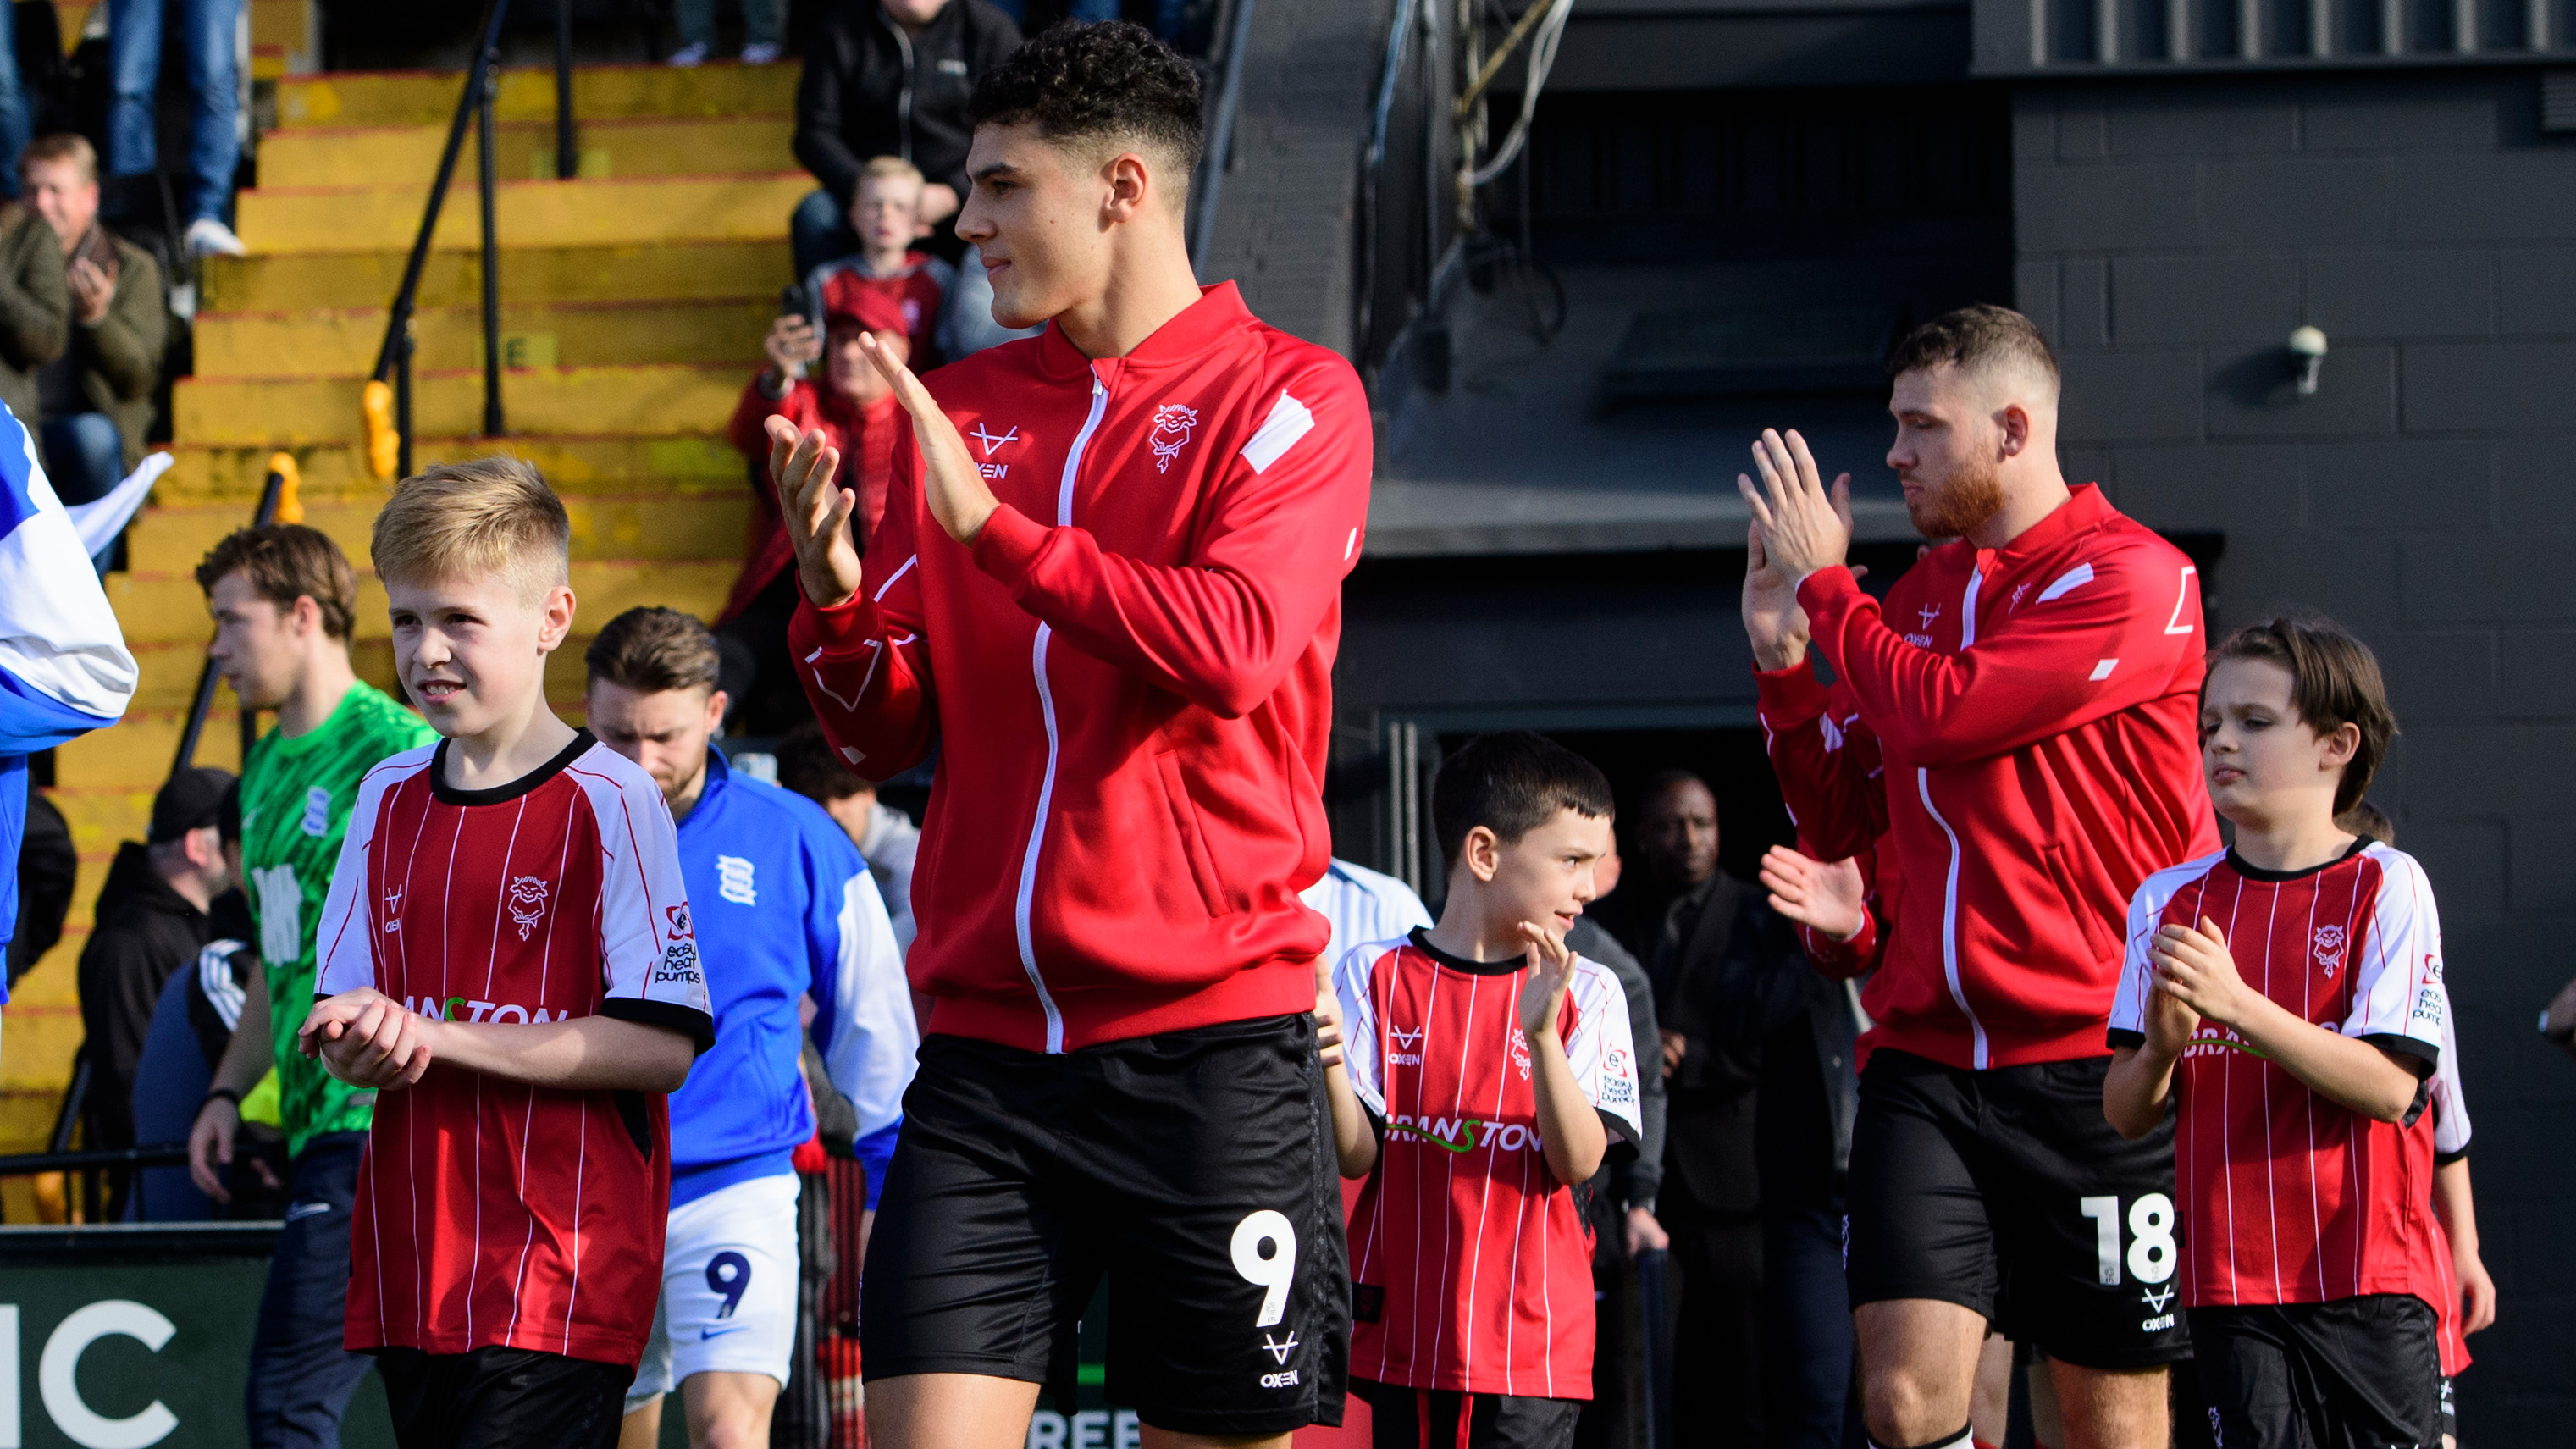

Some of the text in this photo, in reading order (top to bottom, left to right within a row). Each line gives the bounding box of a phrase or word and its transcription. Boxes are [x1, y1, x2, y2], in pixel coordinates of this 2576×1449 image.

[974, 462, 1009, 479] XEN
[667, 943, 696, 960] easy
[664, 956, 696, 971] heat
[655, 971, 701, 984] pumps
[2421, 989, 2441, 1003] eas
[2419, 998, 2441, 1014] hea
[1389, 1054, 1421, 1066] OXEN
[2081, 1193, 2177, 1286] 18
[1230, 1209, 1297, 1327] 9
[706, 1251, 751, 1319] 9
[2142, 1314, 2175, 1332] OXEN
[1260, 1369, 1299, 1388] OXEN
